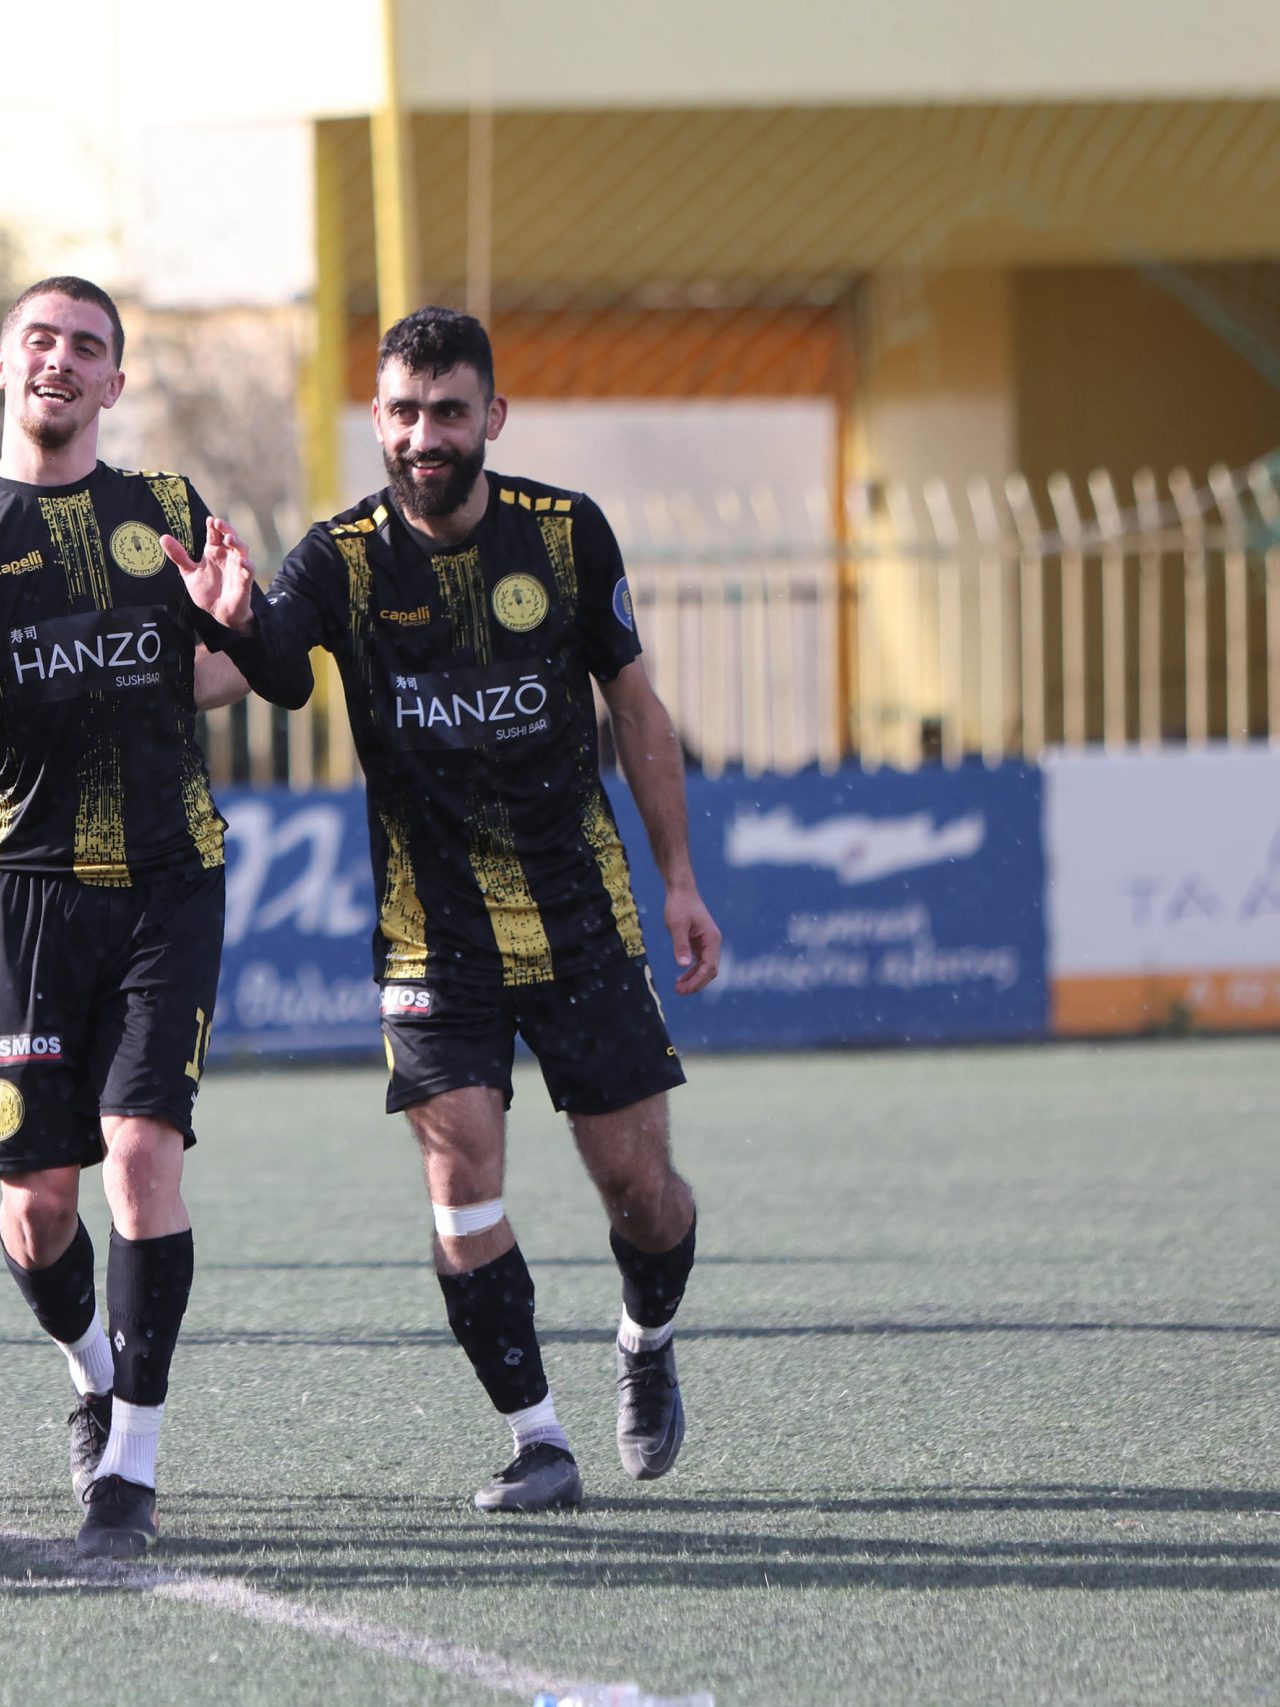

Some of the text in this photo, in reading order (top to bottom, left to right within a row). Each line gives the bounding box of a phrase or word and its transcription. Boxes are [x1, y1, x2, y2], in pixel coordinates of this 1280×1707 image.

[379, 605, 431, 624] capelli
[13, 622, 161, 684] HANZŌ
[145, 672, 160, 684] BAR
[396, 674, 548, 729] HANZŌ
[495, 718, 548, 741] SUSHI BAR
